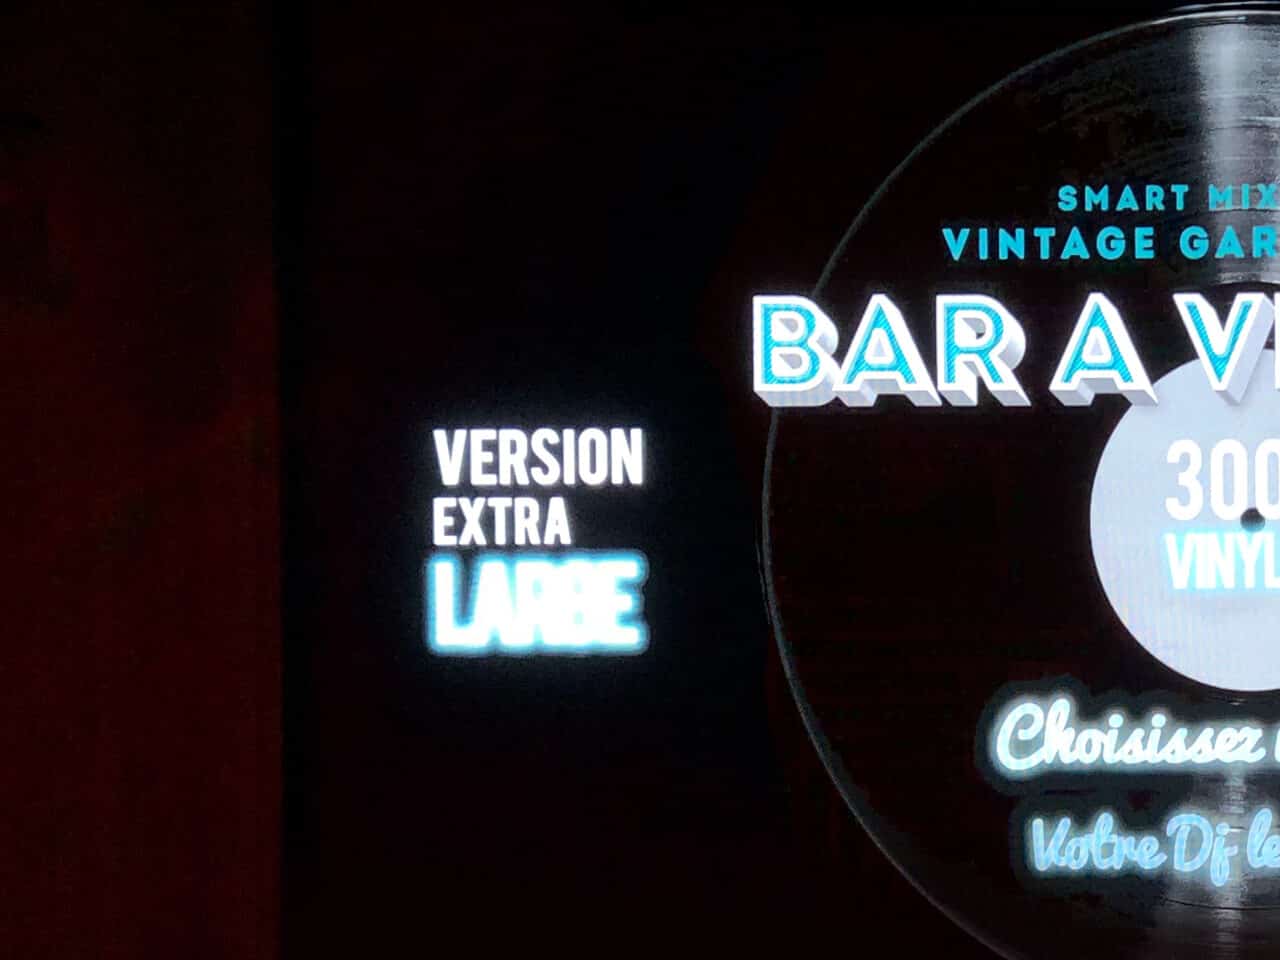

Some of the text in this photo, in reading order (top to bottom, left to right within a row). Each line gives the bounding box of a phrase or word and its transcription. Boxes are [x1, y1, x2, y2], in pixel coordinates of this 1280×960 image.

[1057, 183, 1189, 212] SMART
[1207, 182, 1278, 211] MIX
[942, 226, 1155, 262] VINTAGE
[752, 293, 1031, 408] BAR
[1049, 292, 1159, 407] A
[432, 427, 643, 486] VERSION
[432, 496, 572, 546] EXTRA
[995, 696, 1265, 771] Choisissez
[1031, 811, 1168, 872] Votre
[1166, 811, 1238, 888] Dj
